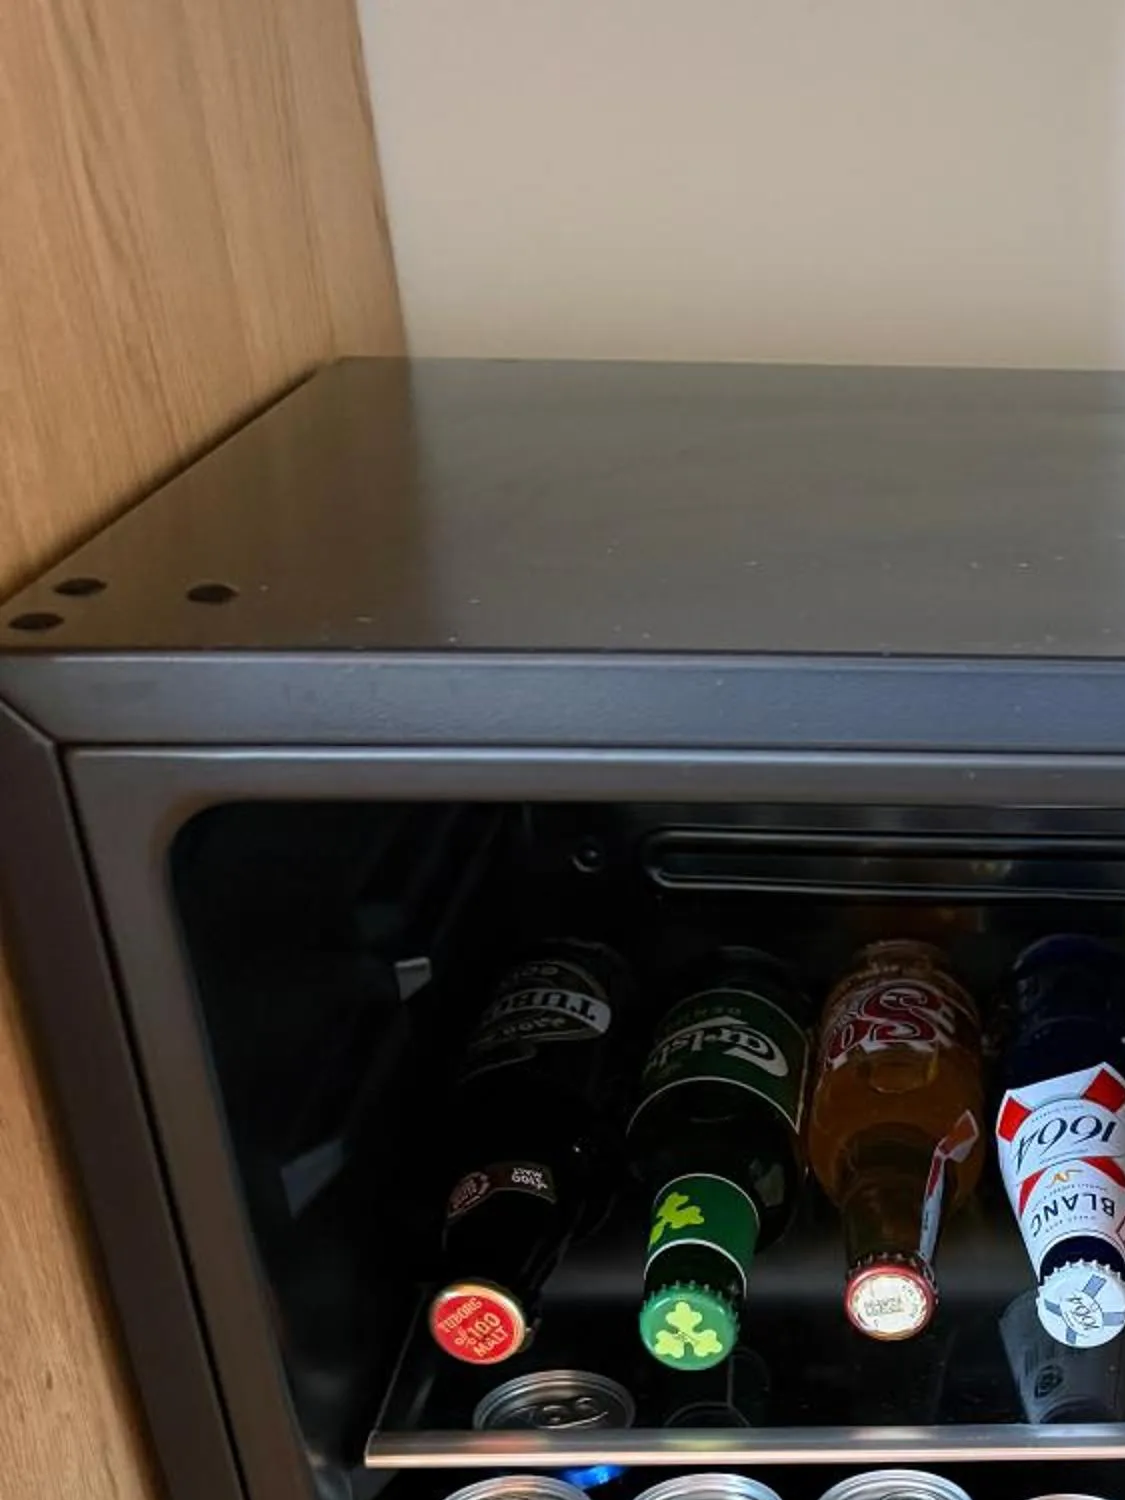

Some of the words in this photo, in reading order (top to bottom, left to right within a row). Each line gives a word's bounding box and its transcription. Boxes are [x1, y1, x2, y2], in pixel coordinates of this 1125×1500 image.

[1015, 1115, 1116, 1175] 1664
[1029, 1192, 1116, 1238] BLANC
[453, 1311, 501, 1348] %100
